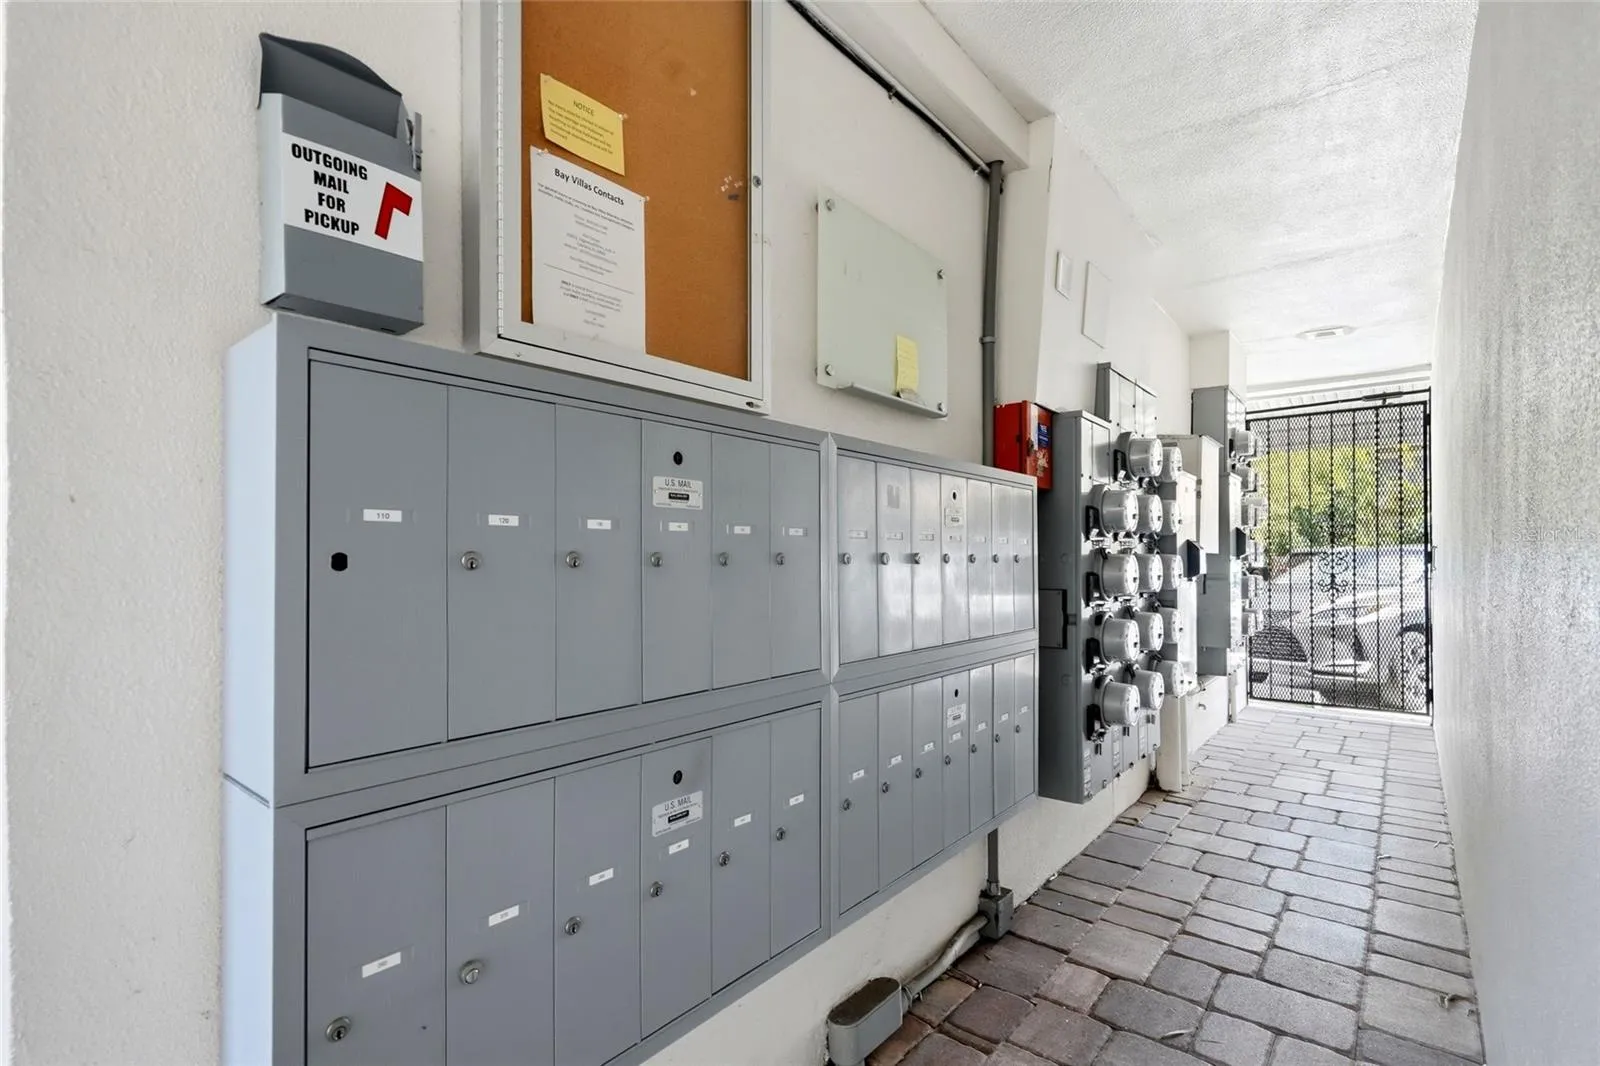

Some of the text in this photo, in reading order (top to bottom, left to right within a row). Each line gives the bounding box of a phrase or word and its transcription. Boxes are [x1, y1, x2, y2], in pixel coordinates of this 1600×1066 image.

[573, 100, 595, 117] NOTICE
[291, 143, 368, 180] OUTGOING
[313, 170, 349, 194] MAIL
[554, 168, 625, 206] Bay Villas Contacts
[317, 192, 346, 213] FOR
[304, 208, 360, 236] PICKUP
[664, 478, 692, 488] U.S. MAIL
[376, 512, 390, 520] 110
[664, 796, 692, 811] U.S. MAIL
